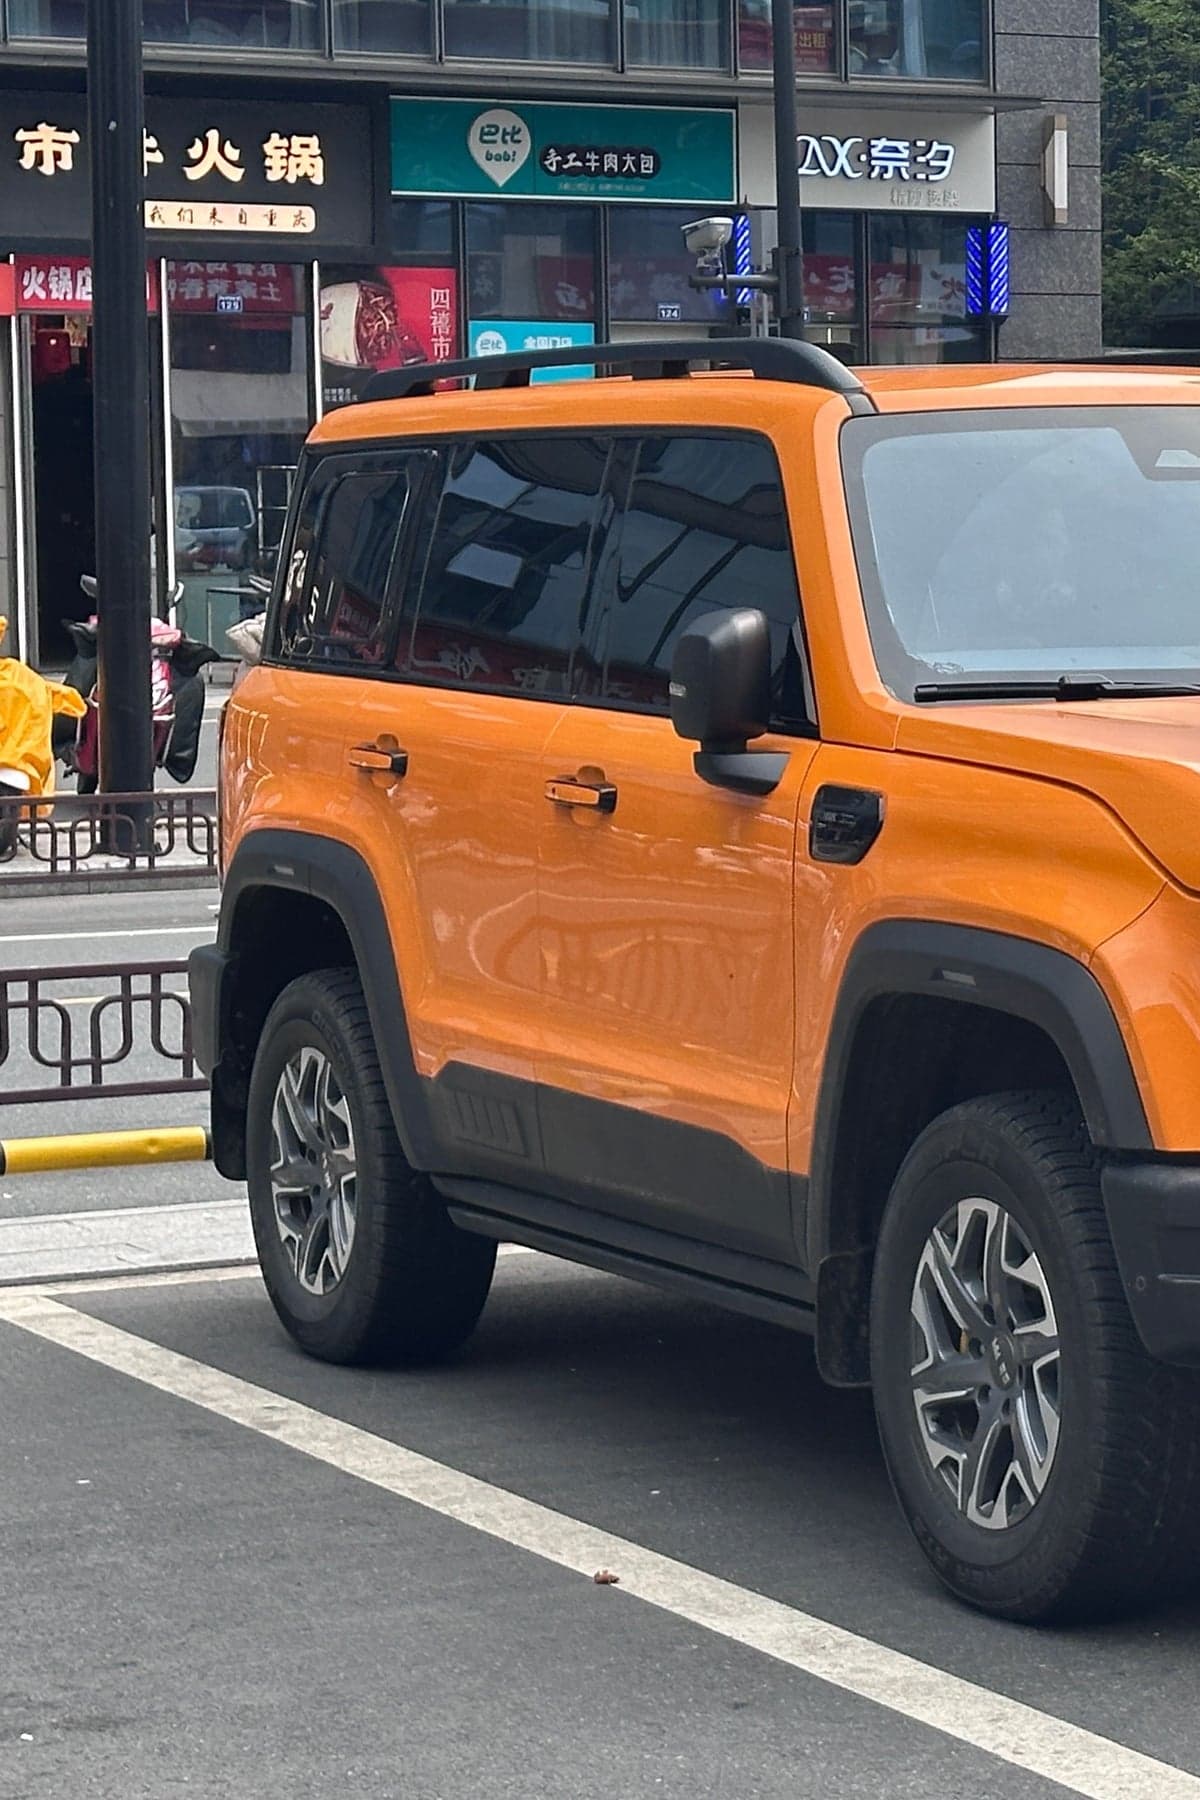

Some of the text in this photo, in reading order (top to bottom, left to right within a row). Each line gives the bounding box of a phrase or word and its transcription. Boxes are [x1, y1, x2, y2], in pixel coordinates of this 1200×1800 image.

[794, 32, 825, 48] 出租
[479, 124, 522, 144] 巴比
[543, 148, 655, 174] 手工牛肉大包
[149, 205, 309, 229] 我们来自重庆
[430, 287, 452, 362] 四禧市
[660, 309, 678, 318] 124
